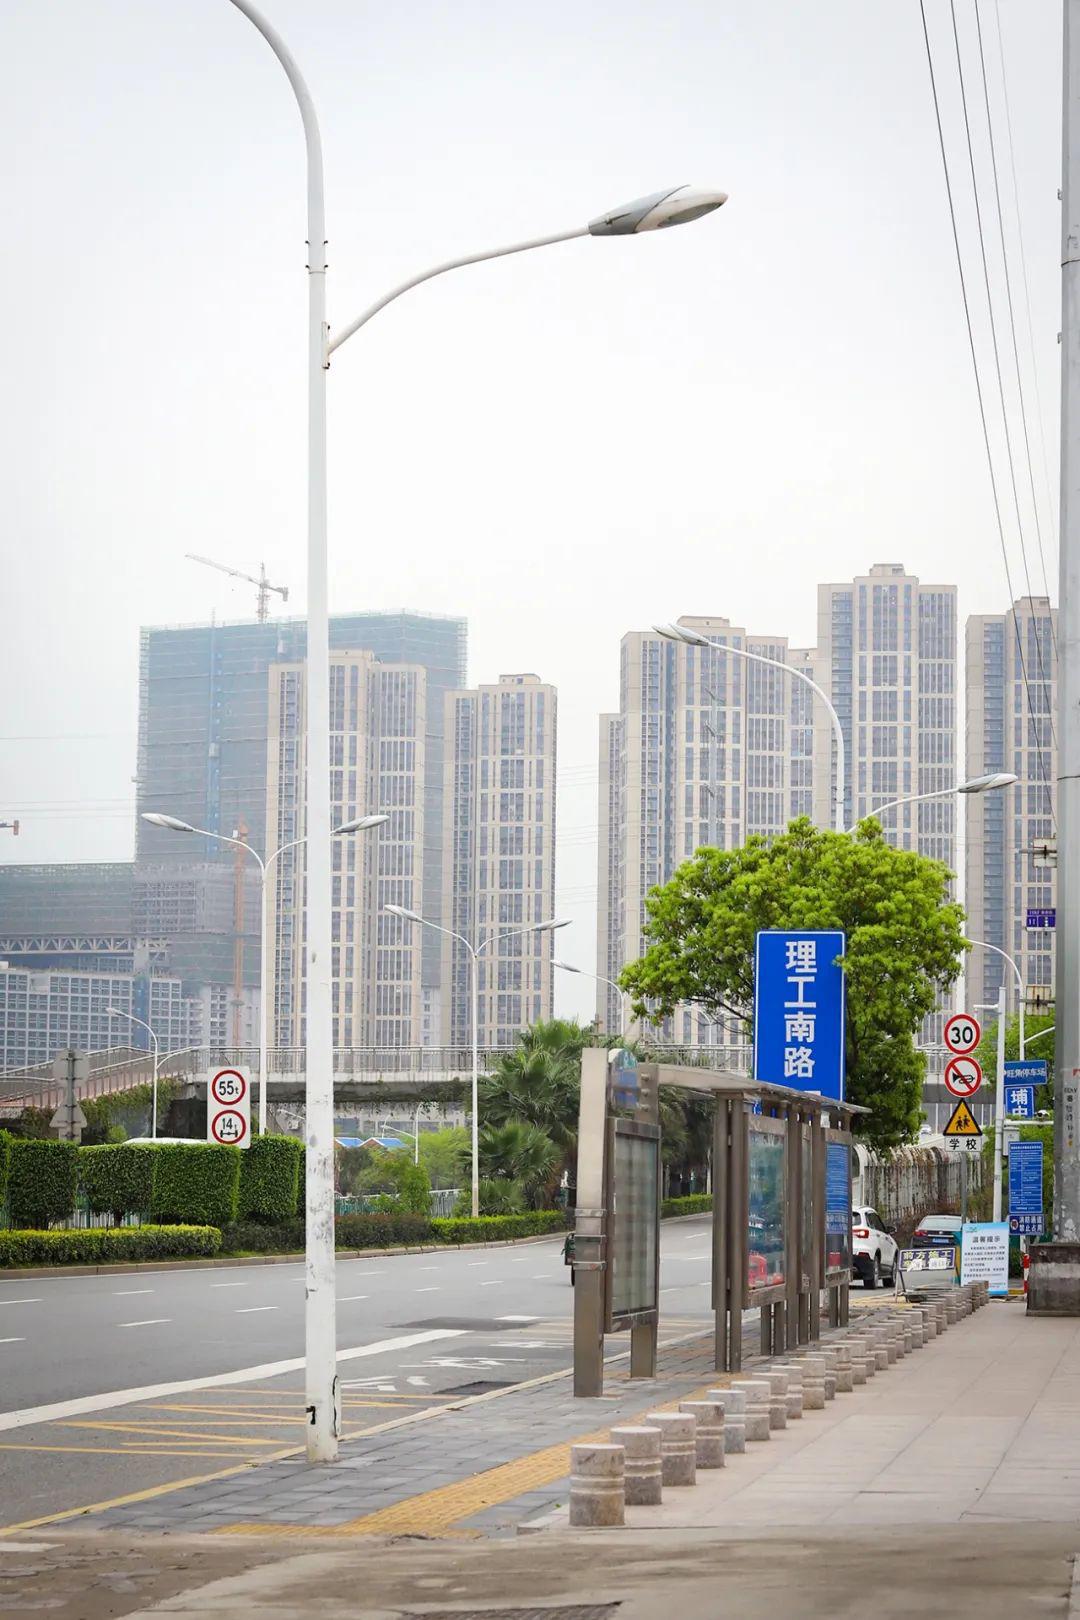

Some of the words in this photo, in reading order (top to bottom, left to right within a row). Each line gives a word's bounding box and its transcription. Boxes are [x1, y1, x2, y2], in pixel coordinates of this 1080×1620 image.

[784, 941, 817, 1078] 理工南路
[951, 1026, 973, 1044] 30
[219, 1081, 239, 1095] 55t
[949, 1139, 977, 1150] 学校
